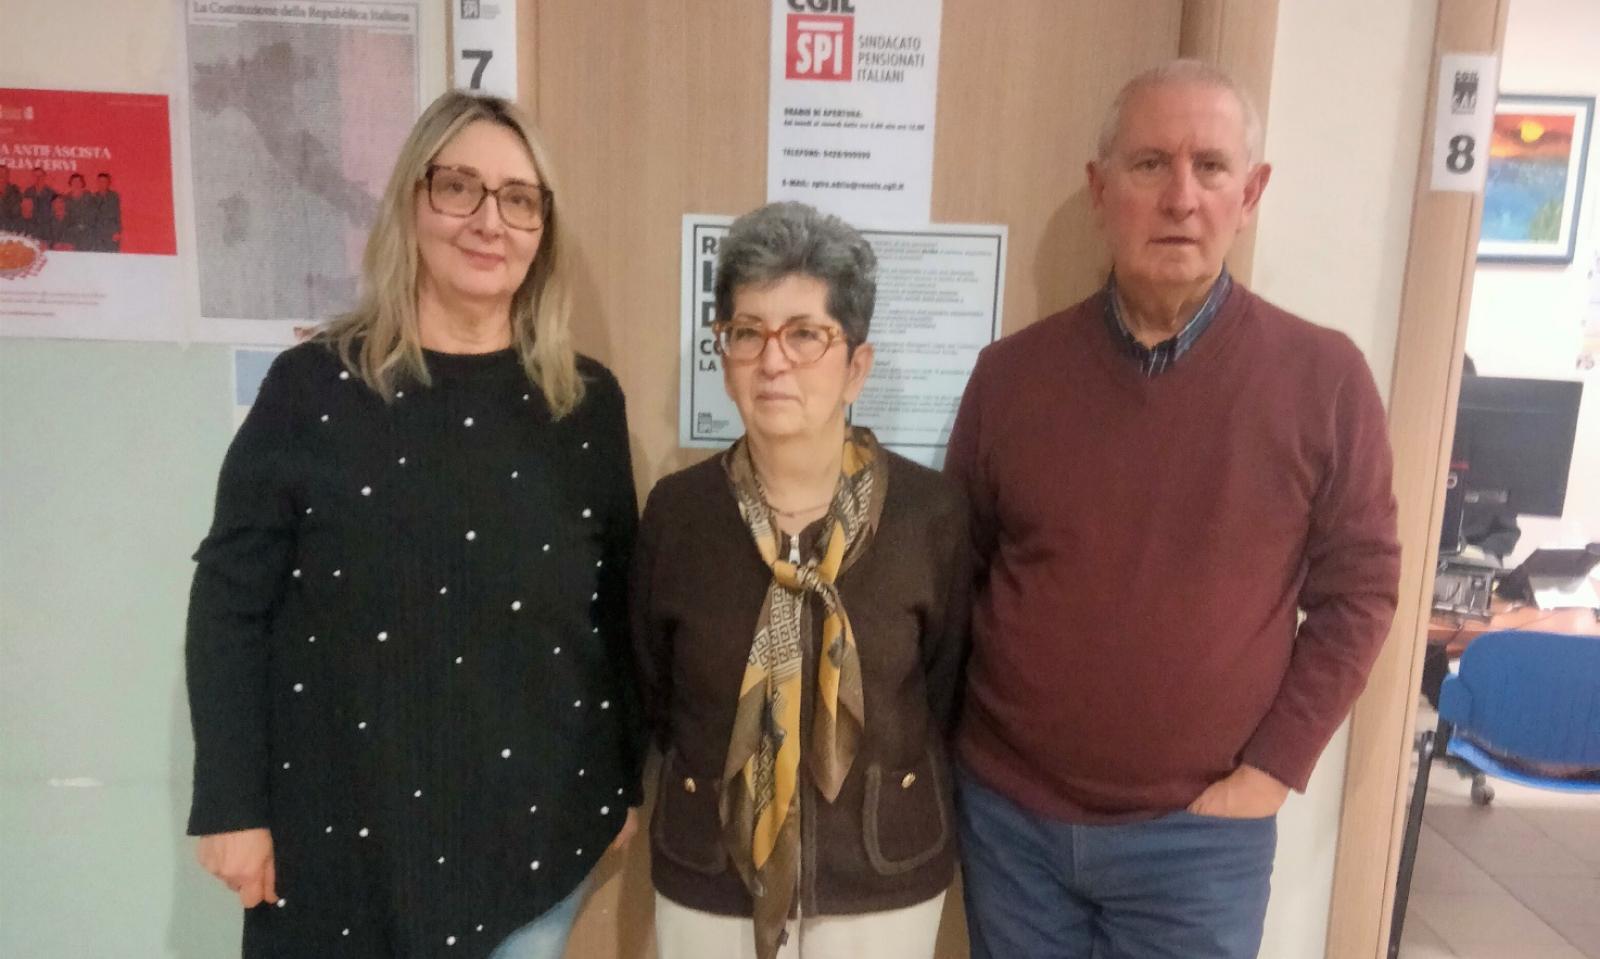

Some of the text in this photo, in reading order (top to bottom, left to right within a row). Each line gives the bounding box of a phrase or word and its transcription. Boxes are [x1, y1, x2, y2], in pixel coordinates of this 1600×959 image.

[193, 2, 409, 22] La Costituzione della Repubblica Italiana
[858, 34, 922, 51] SINDACATO
[796, 32, 844, 75] SPI
[858, 51, 926, 68] PENSIONATI
[462, 50, 493, 89] 7
[857, 68, 905, 83] ITALIANI
[823, 109, 863, 119] APERTURA:
[13, 144, 112, 160] ANTIFASCISTA
[783, 148, 820, 158] TELEFONO:
[1446, 134, 1475, 175] 8
[699, 360, 717, 372] LA
